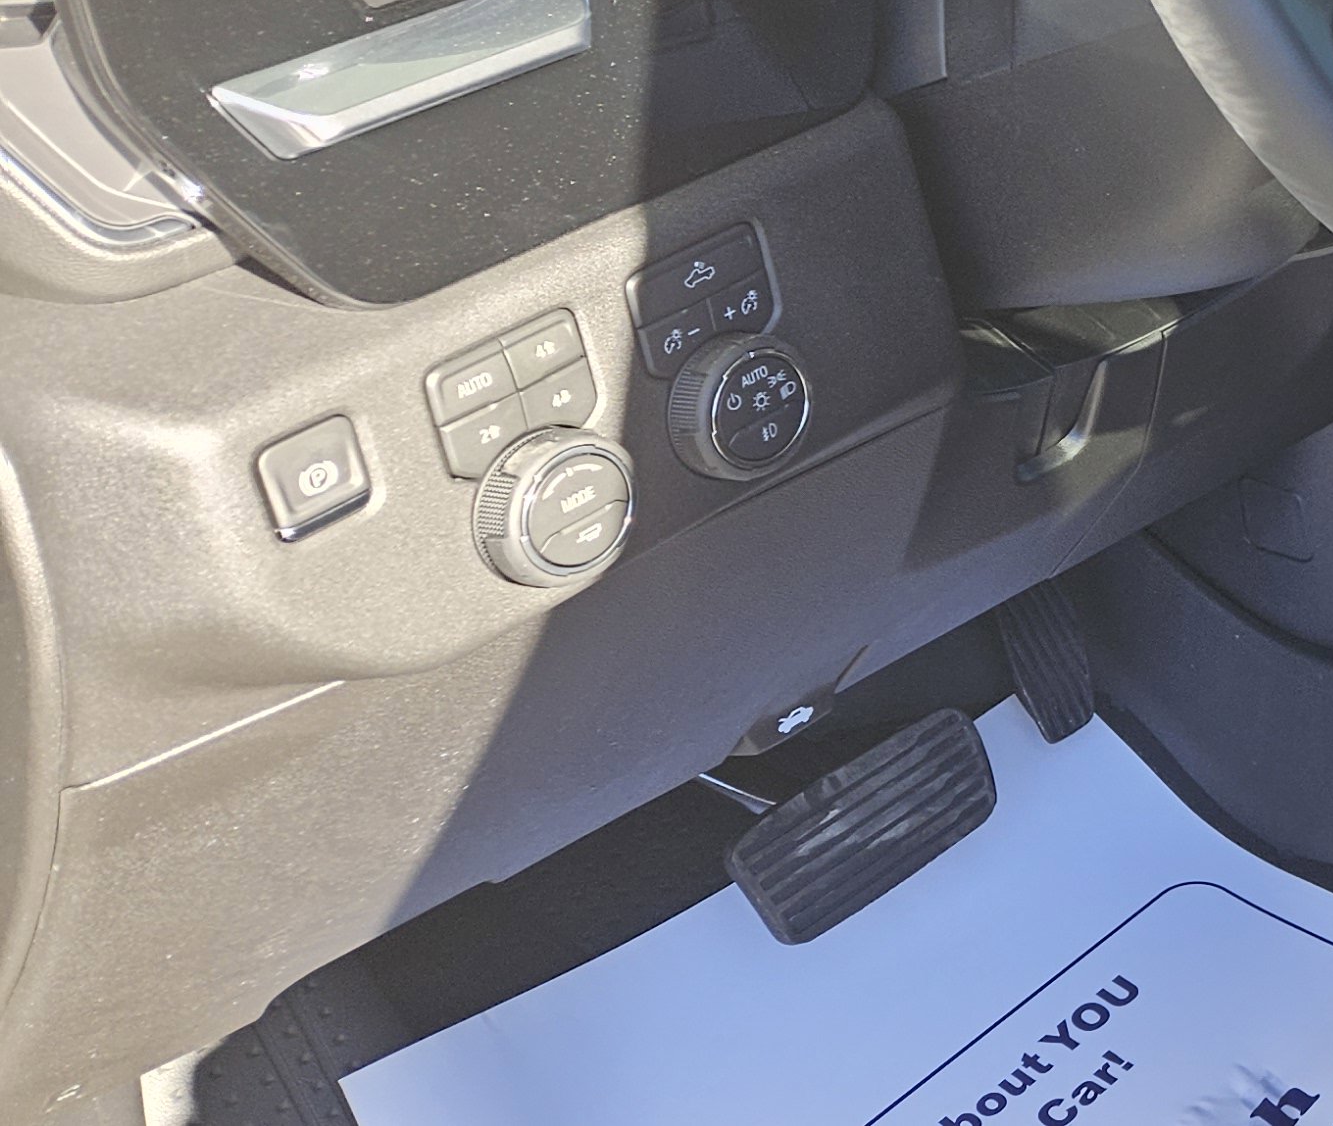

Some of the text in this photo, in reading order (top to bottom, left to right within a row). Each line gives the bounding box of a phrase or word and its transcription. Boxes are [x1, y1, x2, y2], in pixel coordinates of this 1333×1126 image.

[456, 372, 493, 399] AUTO
[741, 365, 769, 389] AUTO
[560, 485, 597, 515] MODE
[1037, 975, 1139, 1051] YOU
[1037, 1050, 1135, 1126] Car!
